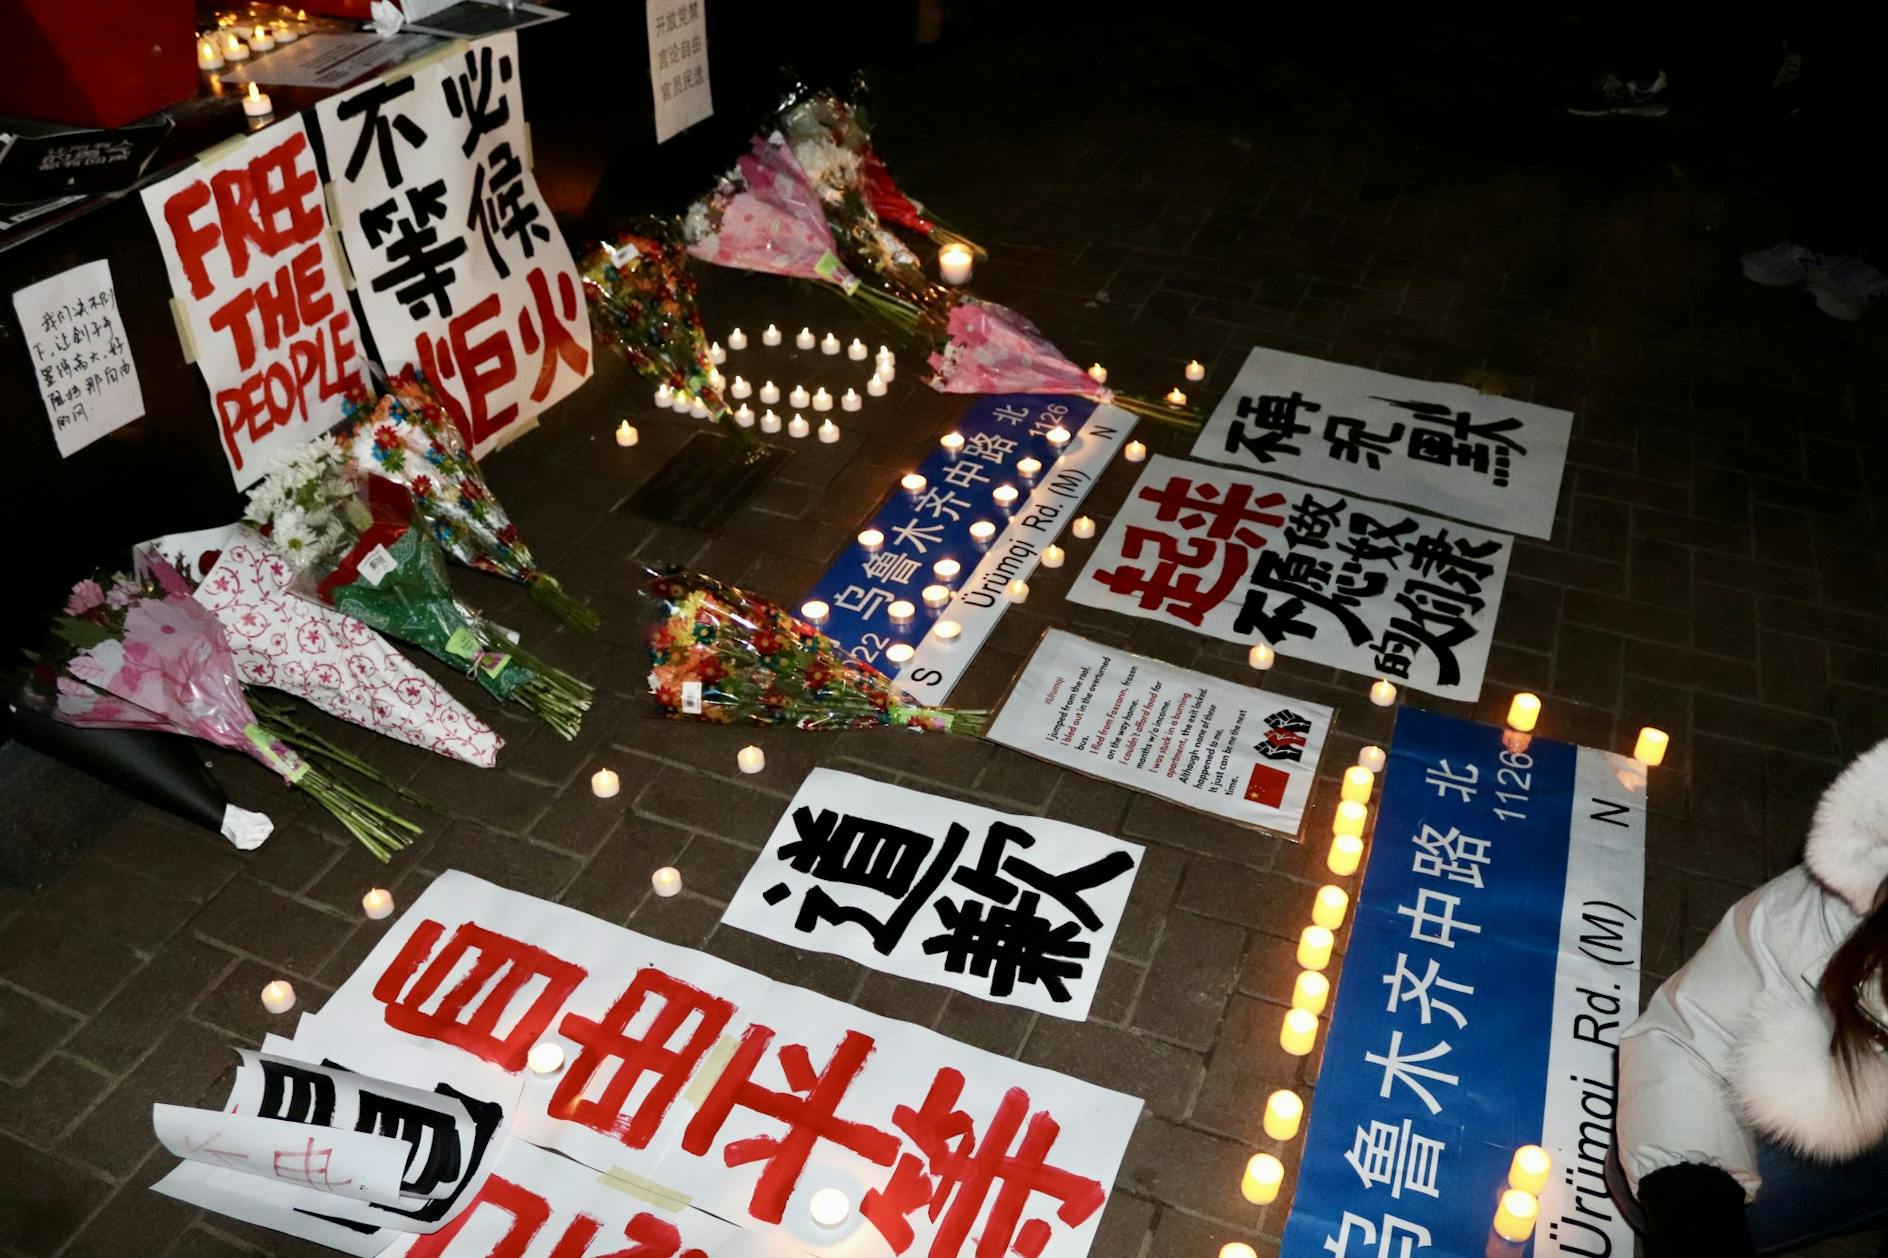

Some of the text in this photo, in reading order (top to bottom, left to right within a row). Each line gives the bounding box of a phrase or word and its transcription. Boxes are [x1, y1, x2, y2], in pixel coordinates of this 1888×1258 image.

[658, 36, 702, 70] 言论自由
[164, 131, 325, 300] FREE
[210, 244, 334, 371] THE
[216, 311, 362, 470] PEOPLE
[1029, 403, 1068, 437] 1126
[833, 404, 1029, 620] 乌鲁木齐中路 北
[911, 425, 1117, 686] S Ürümqi Rd. (M) N
[1092, 476, 1287, 627] 起来
[1087, 655, 1112, 693] overturned
[1120, 665, 1138, 687] frozen
[1149, 680, 1163, 693] for
[1047, 710, 1069, 740] jumped
[1060, 692, 1078, 712] from
[1070, 680, 1084, 693] the
[1075, 704, 1088, 713] in
[1080, 692, 1094, 705] the
[1142, 691, 1159, 711] food
[1169, 692, 1193, 720] burning
[1060, 724, 1078, 743] bled
[1072, 712, 1084, 727] out
[1097, 718, 1114, 736] from
[1106, 698, 1140, 761] on the way home.
[1134, 708, 1151, 734] afford
[1135, 742, 1153, 770] months
[1151, 699, 1172, 728] income.
[1164, 726, 1176, 736] in
[1179, 723, 1194, 737] the
[1187, 708, 1200, 724] exit
[1073, 735, 1091, 751] bus.
[1090, 734, 1106, 751] fled
[1159, 736, 1173, 755] stuck
[1177, 703, 1217, 785] Although none of these
[1207, 709, 1248, 794] It just can be me the next
[1152, 754, 1165, 770] was
[1191, 747, 1216, 790] happened
[1208, 740, 1219, 749] to
[1223, 775, 1240, 796] time.
[1426, 759, 1479, 803] 北
[1493, 750, 1533, 821] 1126
[1590, 798, 1630, 828] N
[762, 806, 1136, 1003] 道歉
[1578, 901, 1637, 965] (M)
[1572, 983, 1621, 1051] Rd.
[373, 918, 1105, 1258] 自由平等
